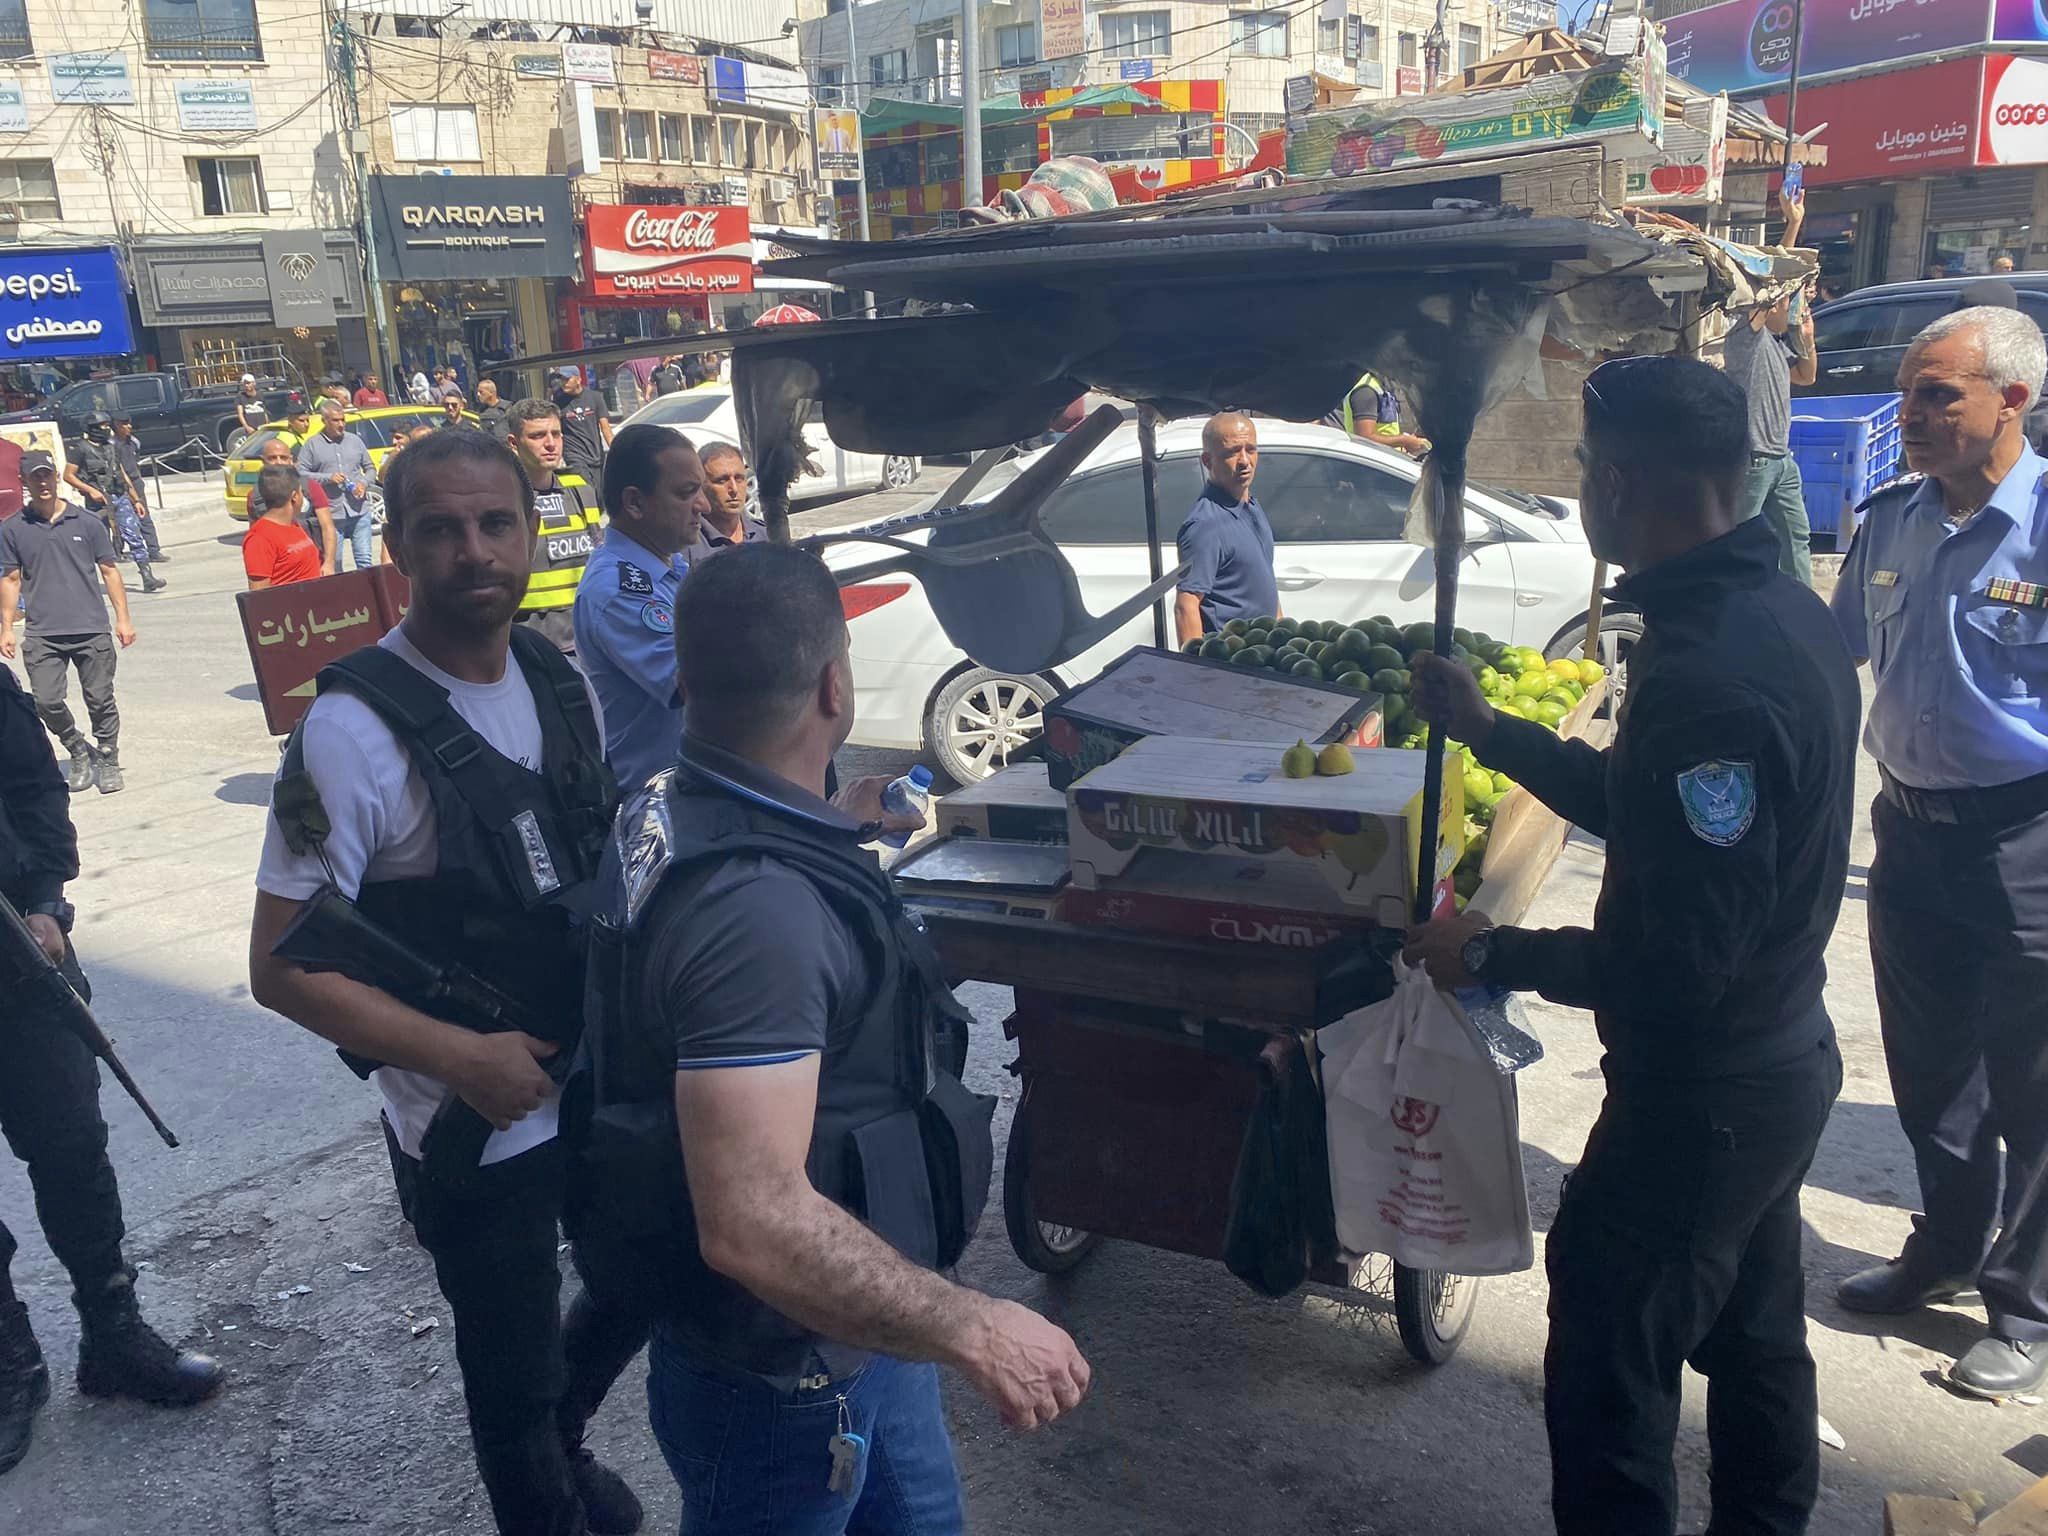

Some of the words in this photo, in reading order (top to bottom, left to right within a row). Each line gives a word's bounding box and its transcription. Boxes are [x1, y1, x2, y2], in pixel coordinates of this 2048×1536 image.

[1875, 129, 1926, 150] موبايل
[1930, 121, 1968, 142] جنين
[402, 206, 545, 228] QARQASH
[445, 236, 510, 247] BOUTIQUE
[0, 266, 82, 300] epsi
[614, 273, 657, 290] بيروت
[659, 271, 705, 288] ماركت
[706, 274, 740, 289] سوبر
[6, 316, 103, 343] مصطفى
[257, 605, 371, 647] سيارات
